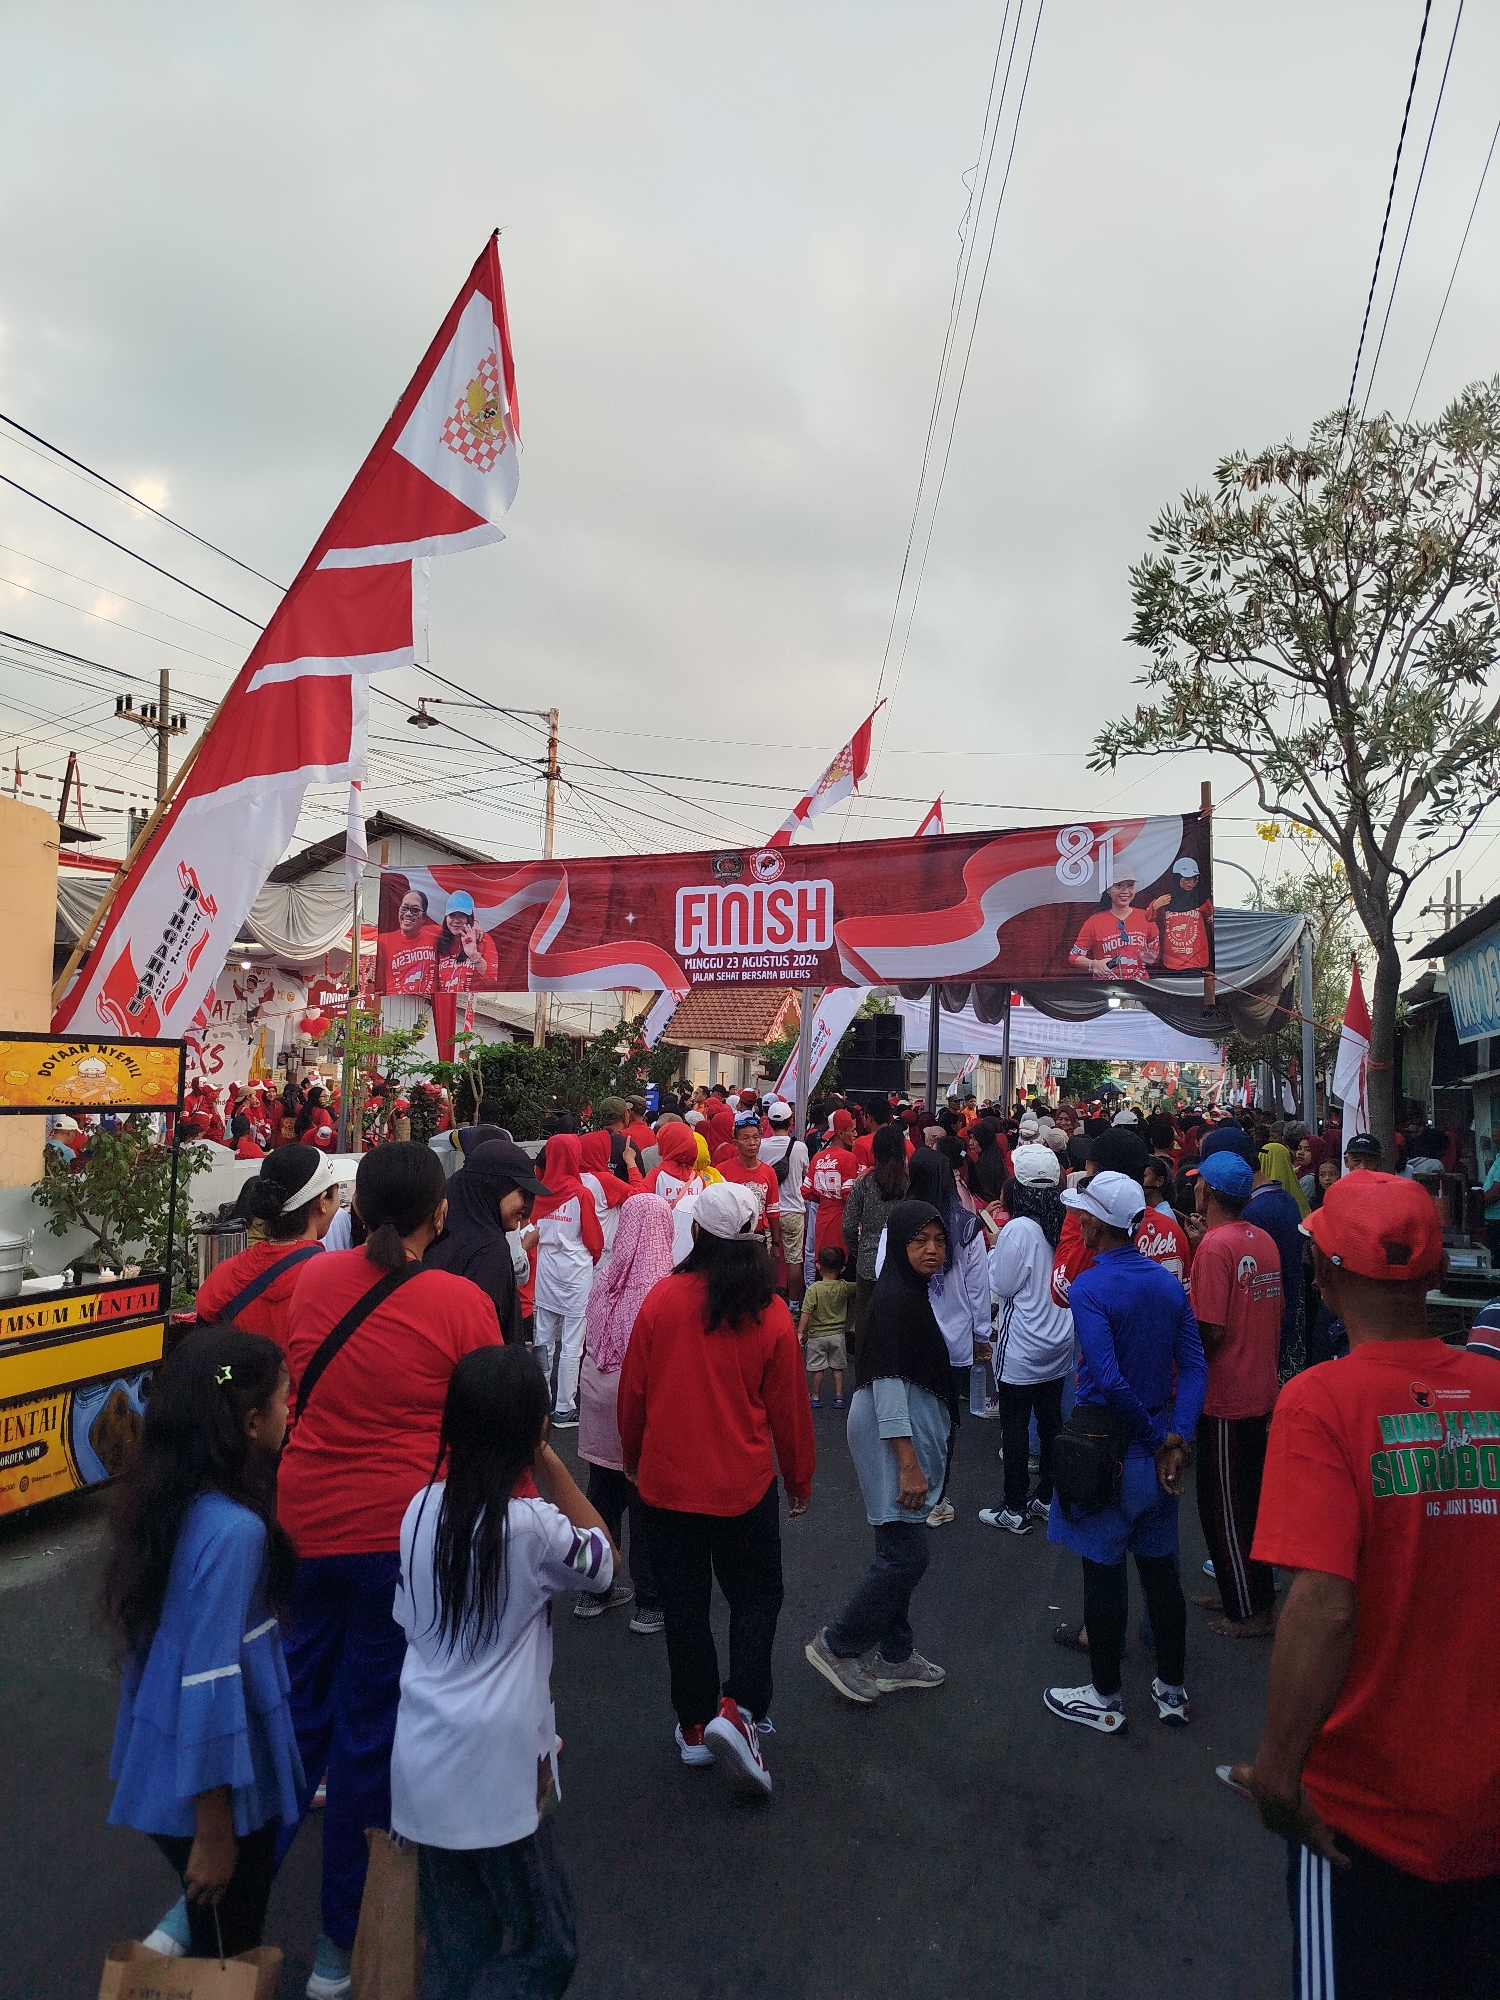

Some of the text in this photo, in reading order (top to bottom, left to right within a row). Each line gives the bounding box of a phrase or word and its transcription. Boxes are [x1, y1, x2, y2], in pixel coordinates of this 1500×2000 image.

[1055, 826, 1125, 895] 81
[682, 887, 826, 948] FINISH
[126, 884, 199, 1017] DIRGAHAYU
[170, 912, 201, 966] REPUBLIK
[685, 954, 819, 970] MINGGU 23 AGUSTUS 2026
[692, 969, 811, 983] JALAN SEHAT BERSAMA BULEKS
[37, 1044, 142, 1079] DOYAAN NYEMILL
[78, 1291, 156, 1320] MENTAI
[0, 1405, 57, 1444] ENTAI
[1378, 1412, 1443, 1444] BUNG
[1426, 1497, 1498, 1517] 06 JUNI 1901
